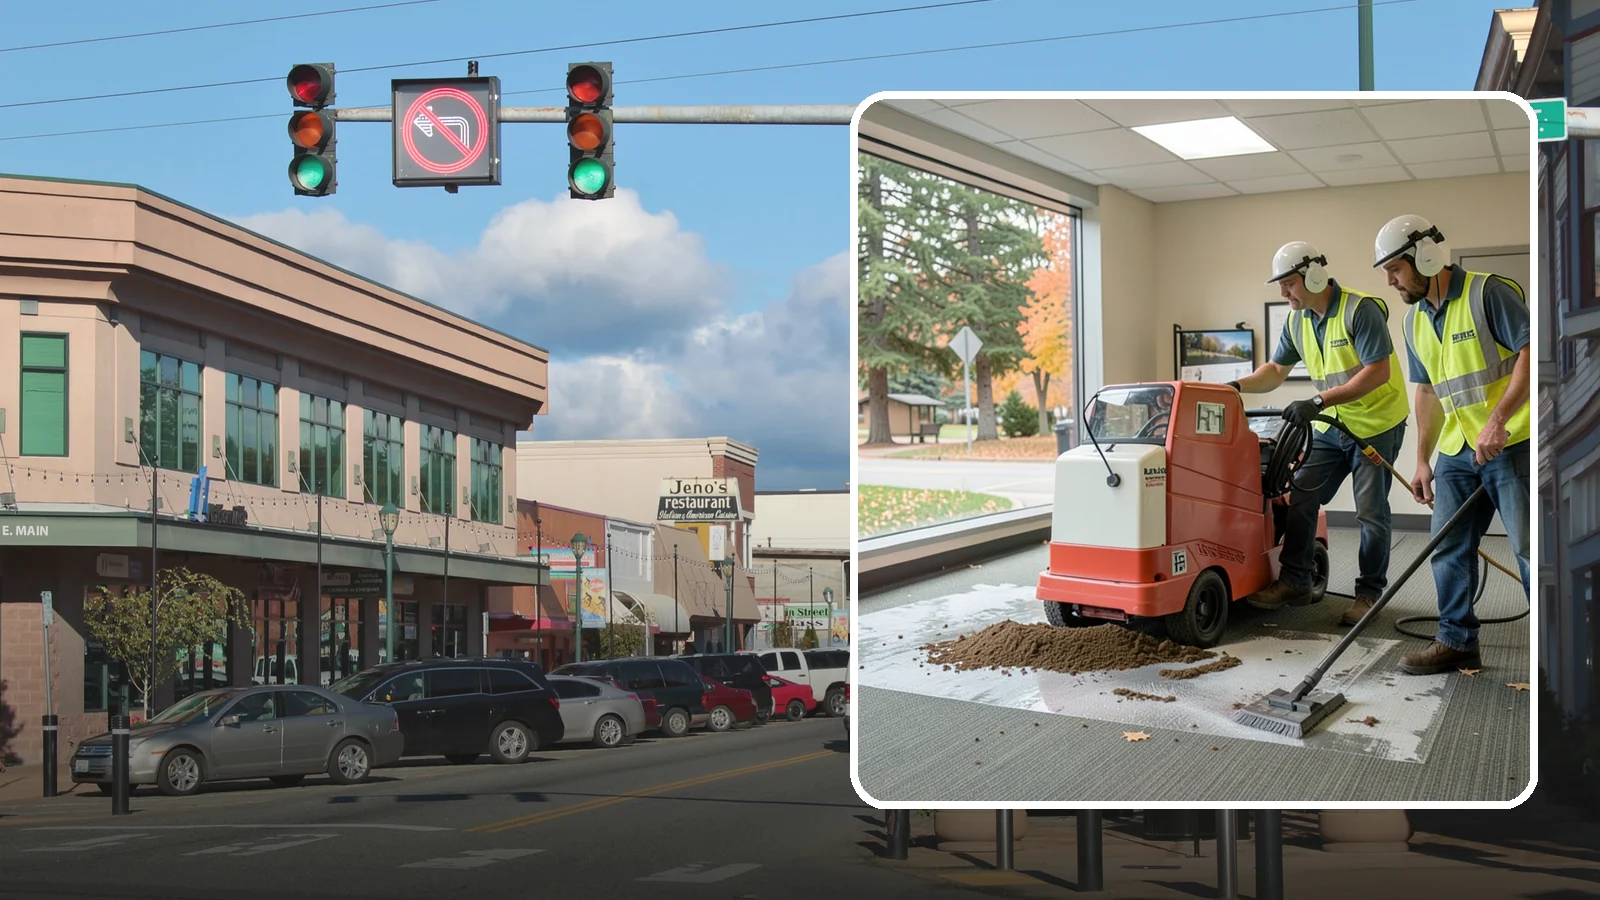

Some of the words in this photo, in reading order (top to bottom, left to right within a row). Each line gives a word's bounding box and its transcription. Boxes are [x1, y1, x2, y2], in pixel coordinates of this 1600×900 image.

[670, 480, 727, 494] Jeno's
[665, 496, 731, 509] restaurant
[658, 510, 682, 520] Italian
[686, 510, 714, 520] American
[715, 510, 737, 519] Cuisine
[2, 525, 13, 536] E.
[15, 525, 49, 536] MAIN
[797, 608, 828, 616] Street
